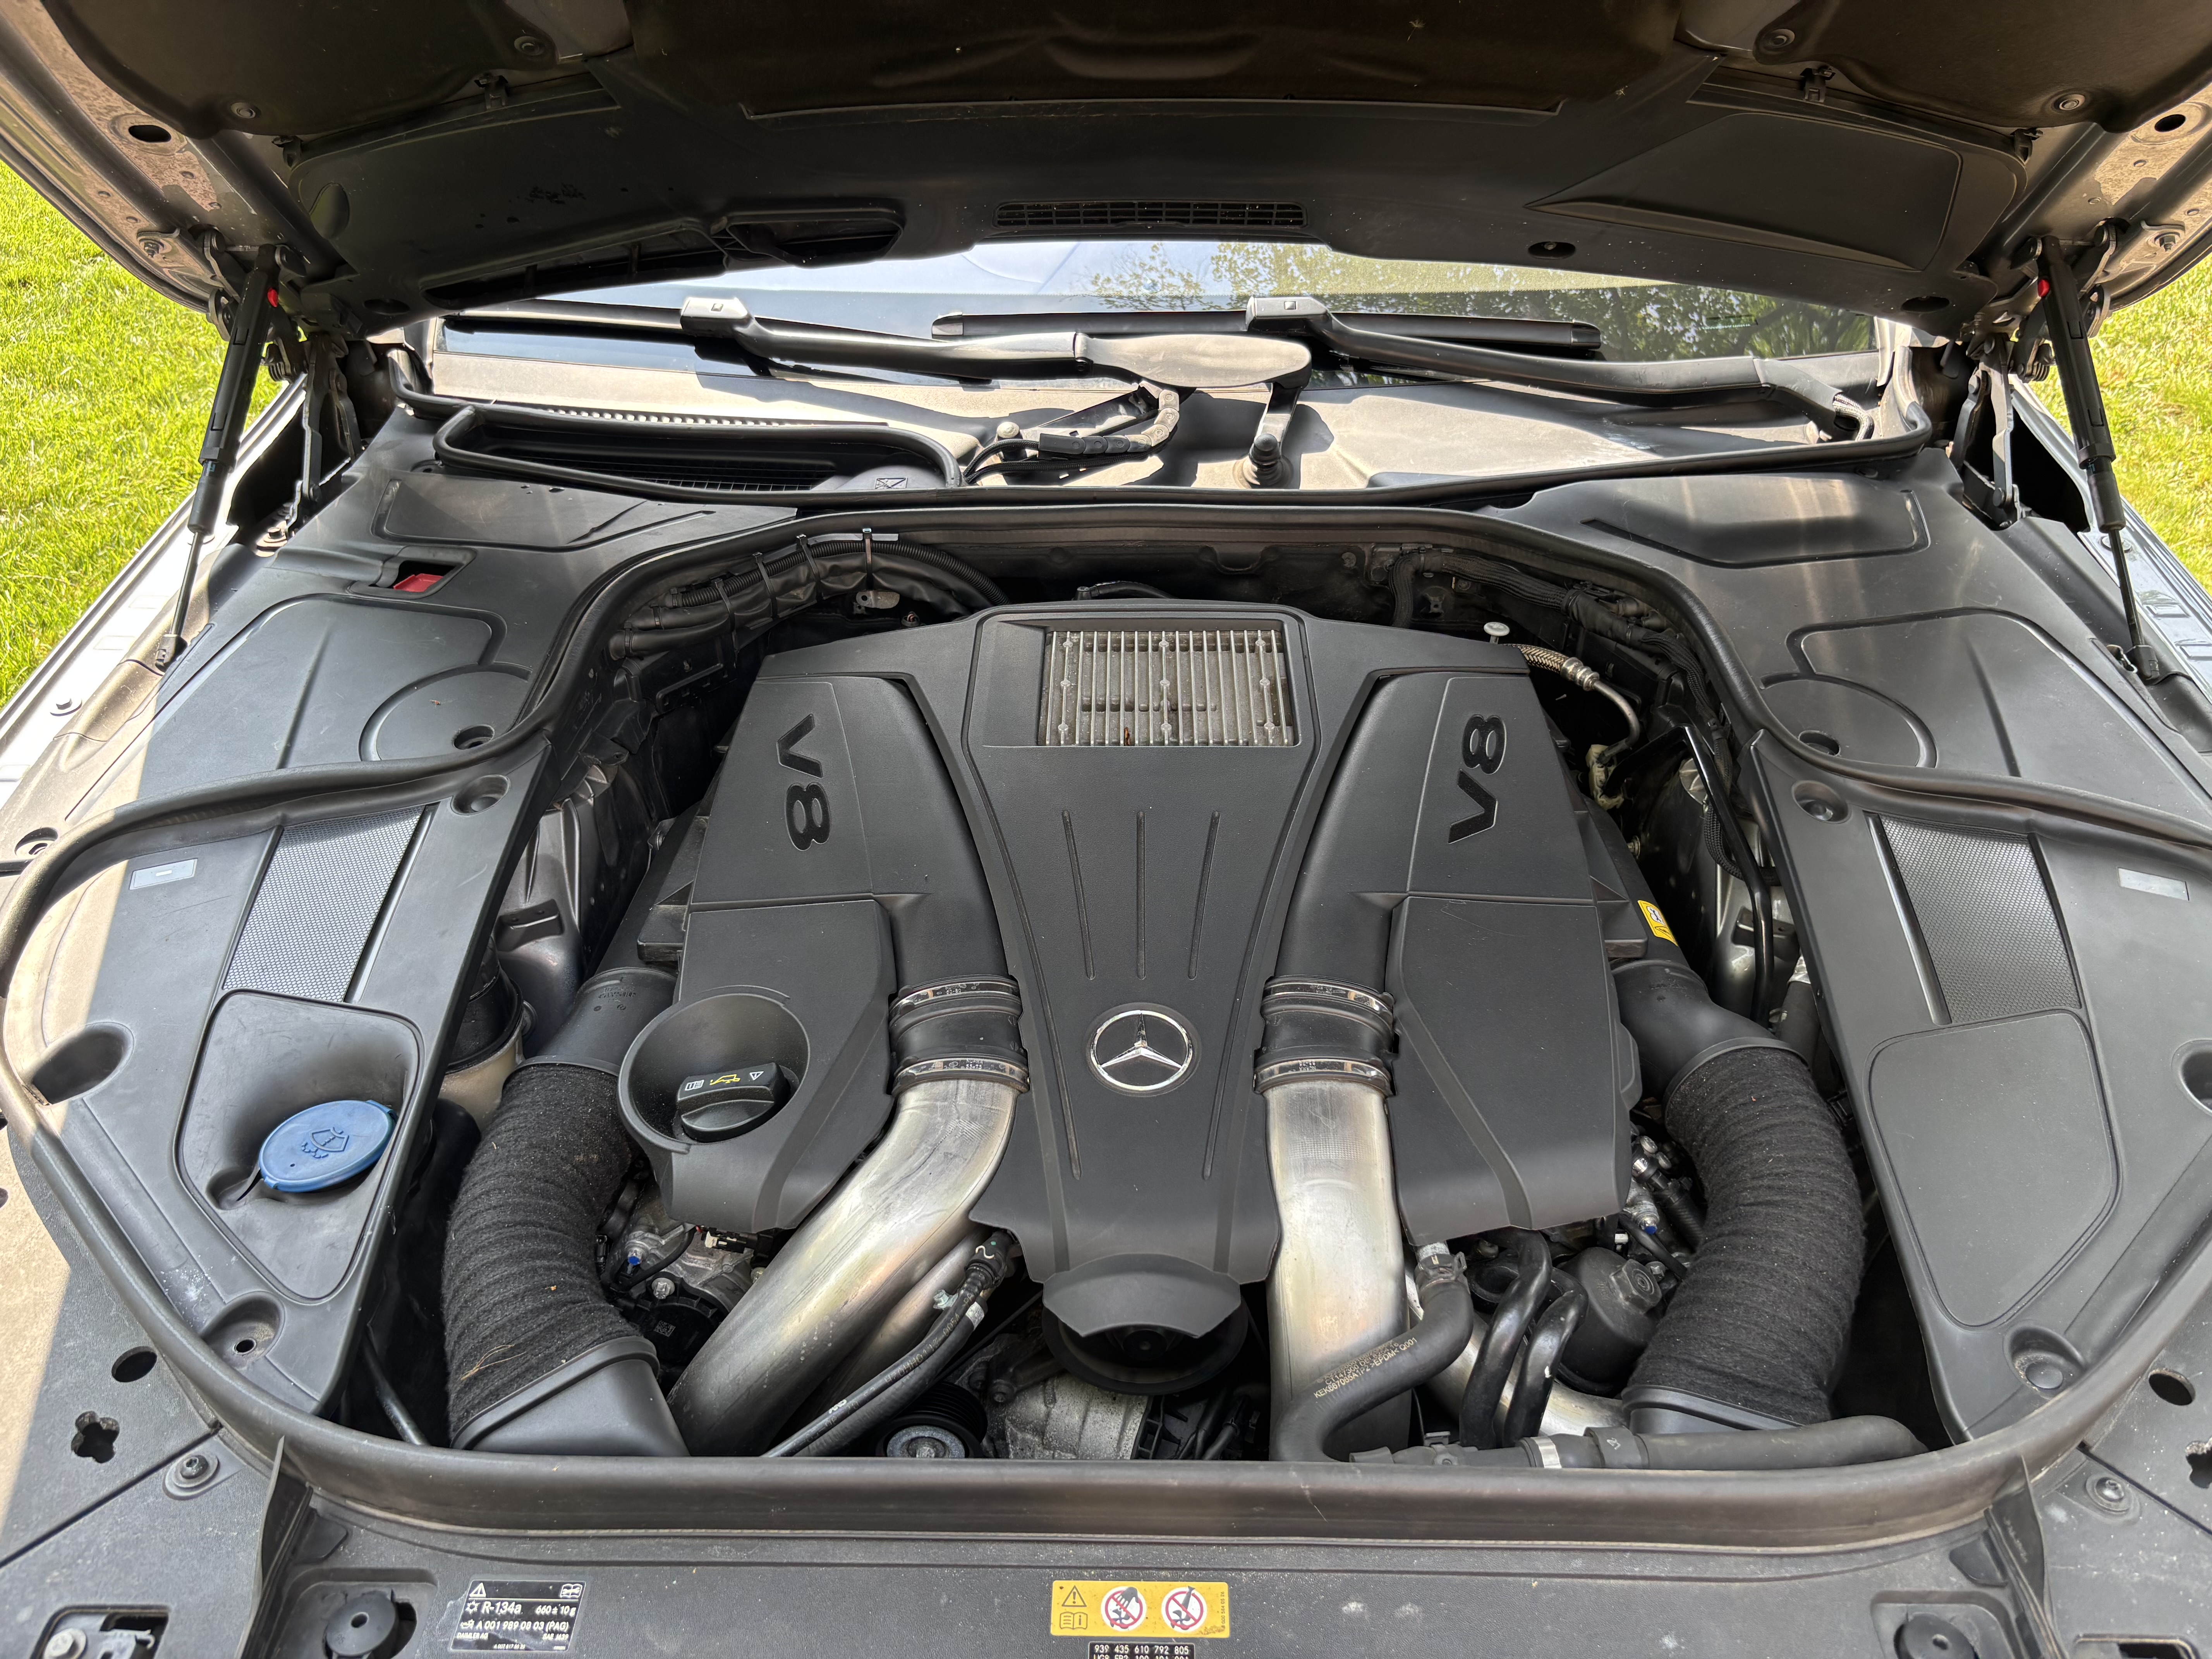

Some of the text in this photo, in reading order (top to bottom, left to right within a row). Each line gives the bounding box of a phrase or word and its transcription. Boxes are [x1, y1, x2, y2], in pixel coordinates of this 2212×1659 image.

[776, 713, 831, 851] V8
[1448, 714, 1507, 844] V8
[1314, 1365, 1370, 1398] KEK667065A1P2
[1399, 1337, 1417, 1351] Q001
[1325, 1364, 1359, 1385] CT147300
[481, 1601, 522, 1614] R-134a
[476, 1621, 483, 1630] A
[484, 1621, 501, 1630] 001
[503, 1621, 519, 1631] 989
[545, 1621, 569, 1632] (PAG)
[1094, 1644, 1189, 1655] 939 435 610 792 805
